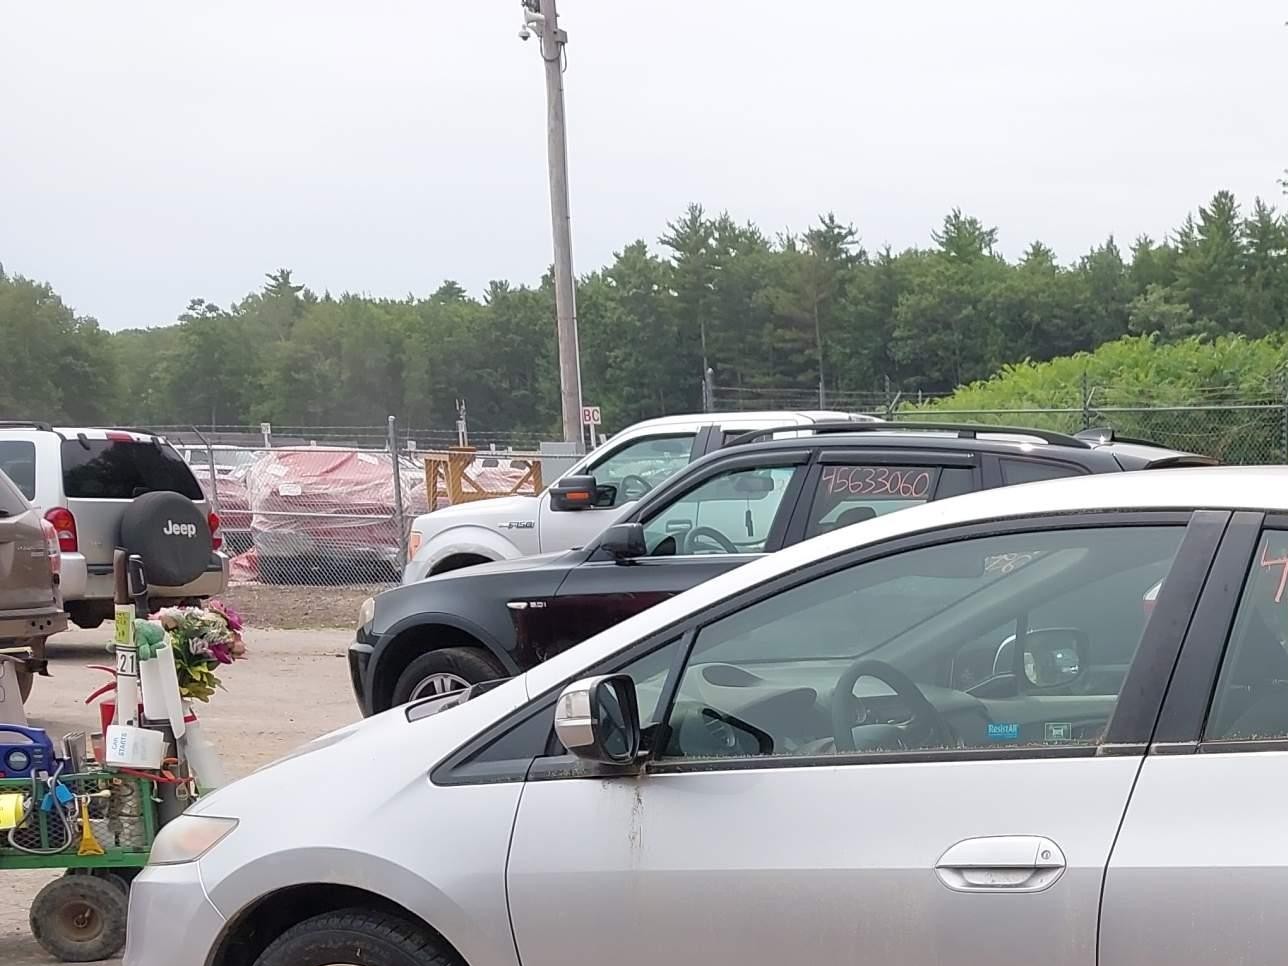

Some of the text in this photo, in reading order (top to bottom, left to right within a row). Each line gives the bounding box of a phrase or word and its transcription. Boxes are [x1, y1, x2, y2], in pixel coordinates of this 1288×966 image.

[583, 408, 600, 422] BC
[821, 466, 929, 497] 45633060
[163, 519, 197, 538] Jeep
